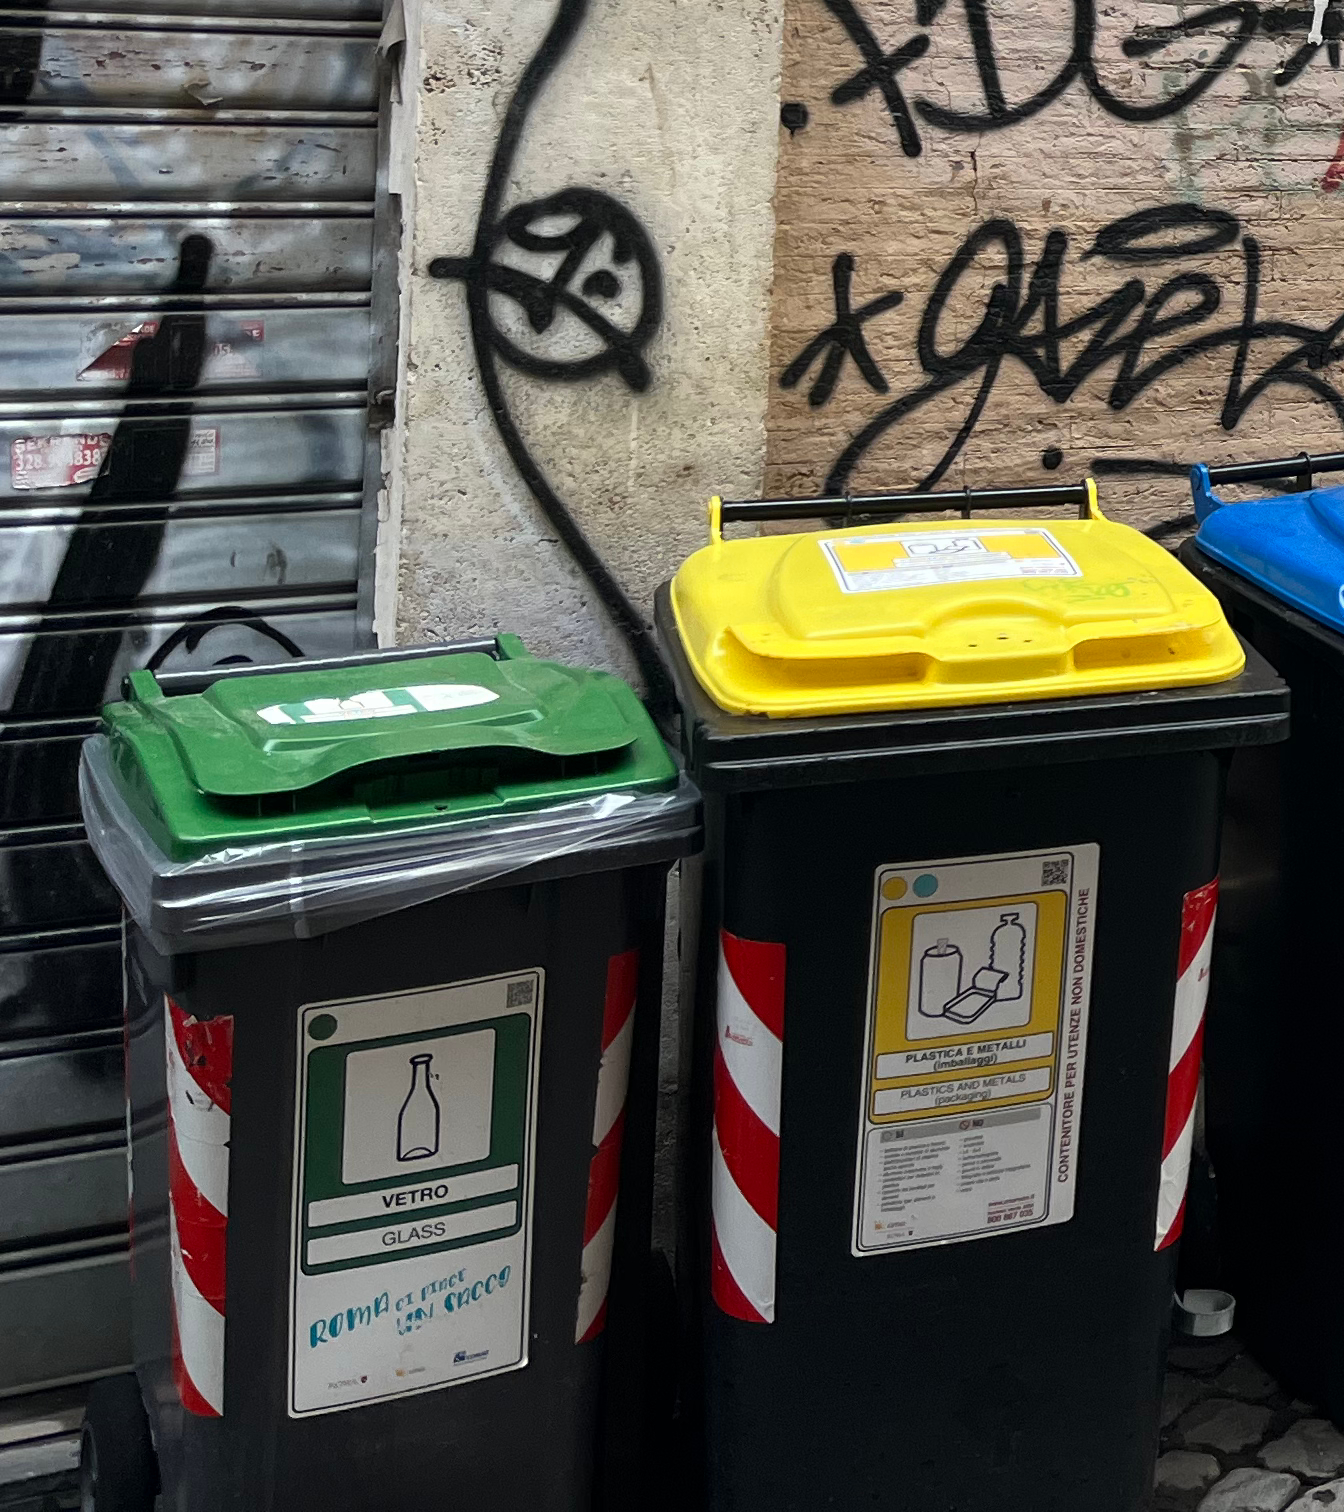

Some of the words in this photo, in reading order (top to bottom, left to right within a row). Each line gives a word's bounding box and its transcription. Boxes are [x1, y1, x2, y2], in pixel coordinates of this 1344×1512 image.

[1075, 888, 1090, 973] DOMESTICHE
[1071, 973, 1083, 1005] NON
[1067, 1007, 1082, 1058] UTENZE
[905, 1048, 963, 1063] PLASTICA
[966, 1046, 974, 1055] E
[977, 1039, 1027, 1054] METALLI
[901, 1083, 954, 1099] PLASTICS
[961, 1080, 980, 1091] AND
[982, 1073, 1026, 1087] METALS
[1065, 1059, 1077, 1088] PER
[1058, 1090, 1075, 1184] CONTENITORE
[382, 1184, 449, 1209] VETRO
[382, 1222, 447, 1247] GLASS
[443, 1264, 512, 1313] SACCO
